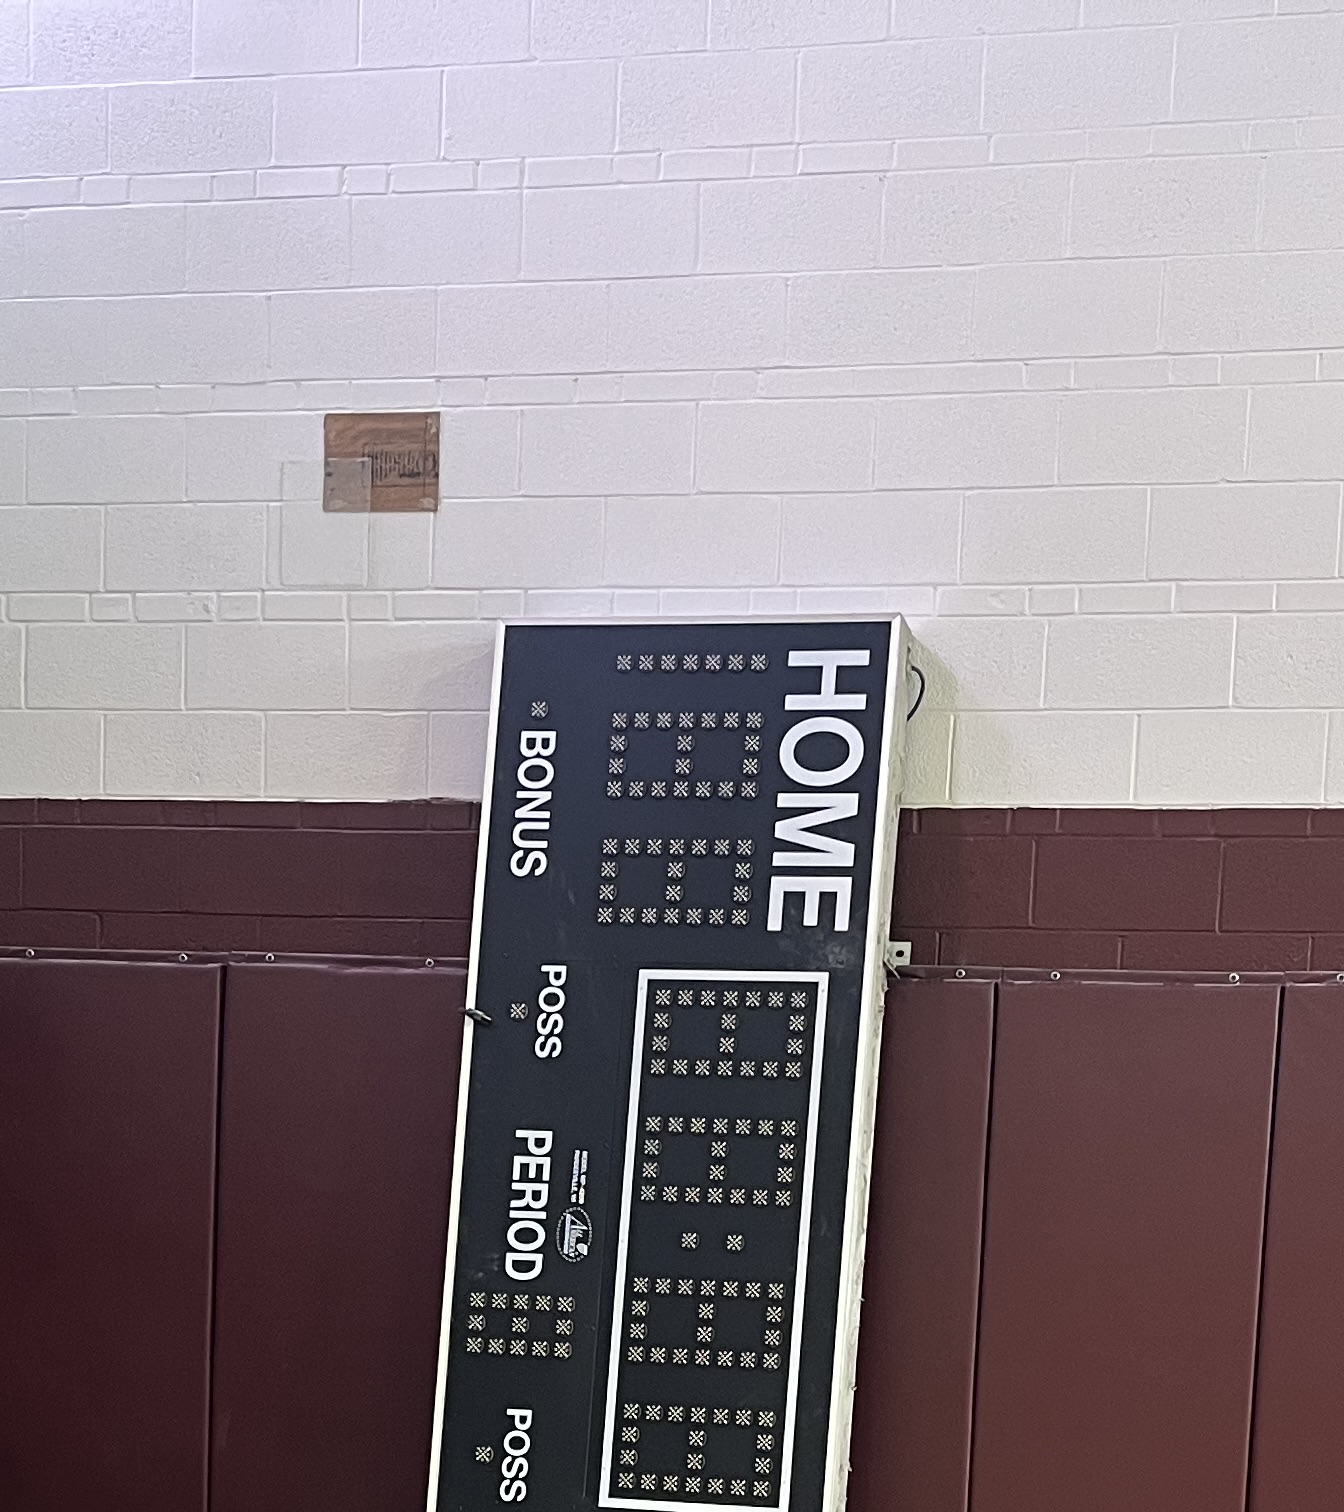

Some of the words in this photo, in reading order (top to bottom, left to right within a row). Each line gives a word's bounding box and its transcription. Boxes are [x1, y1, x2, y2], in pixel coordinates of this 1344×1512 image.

[511, 731, 556, 876] BONUS
[767, 650, 870, 931] HOME
[535, 965, 567, 1058] POSS
[505, 1130, 552, 1280] PERIOD
[500, 1409, 532, 1501] POSS
